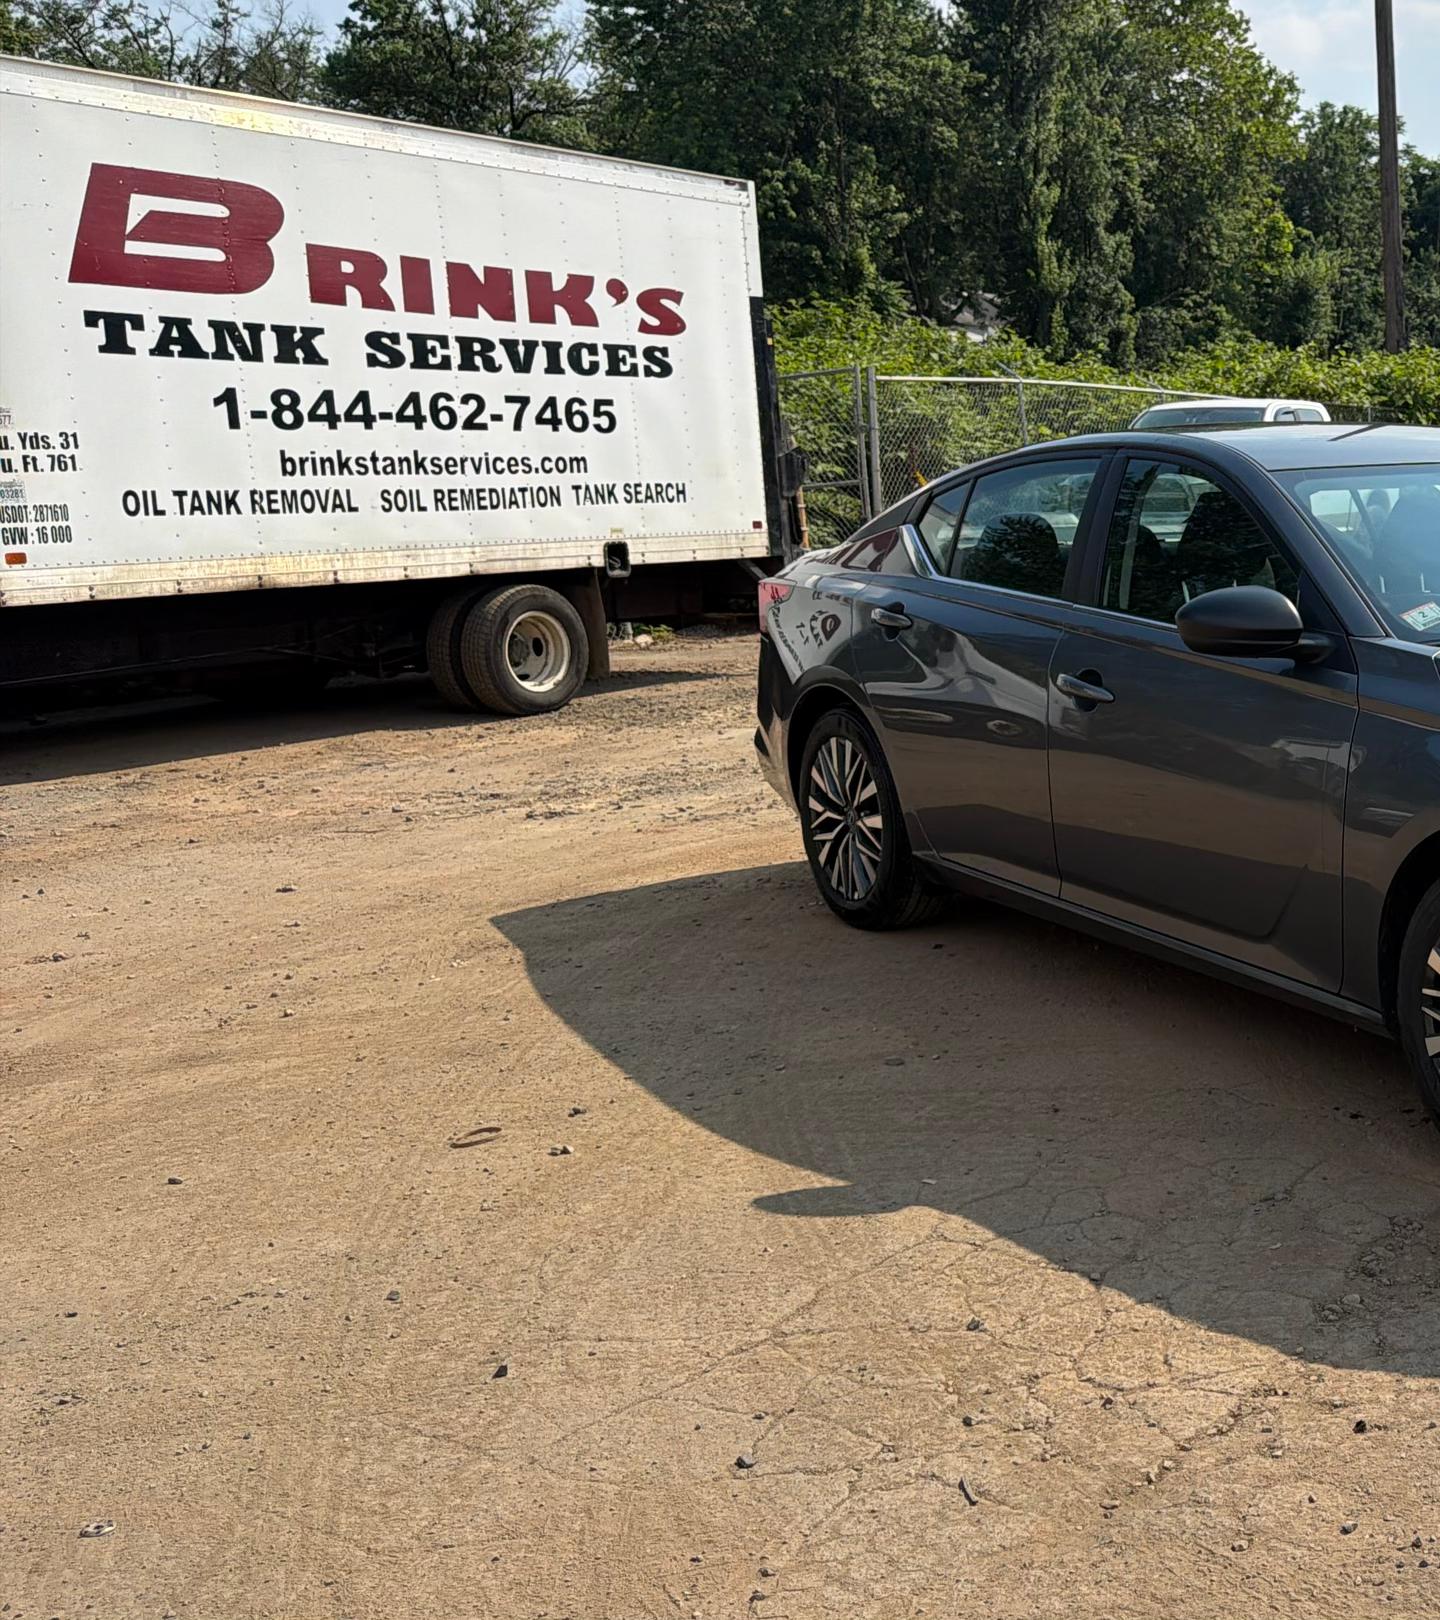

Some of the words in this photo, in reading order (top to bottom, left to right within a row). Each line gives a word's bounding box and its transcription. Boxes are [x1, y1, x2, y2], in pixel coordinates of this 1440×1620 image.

[68, 162, 686, 336] BRINK'S
[83, 310, 329, 366] TANK
[365, 331, 673, 378] SERVICES
[213, 387, 617, 434] 1-844-462-7465
[17, 432, 56, 450] Yds.
[59, 432, 79, 449] 31
[22, 455, 44, 473] Ft.
[47, 454, 77, 472] 761
[280, 449, 588, 477] brinkstankservices.com
[122, 490, 166, 516] OIL
[172, 490, 242, 516] TANK
[250, 489, 359, 514] REMOVAL
[380, 488, 427, 513] SOIL
[433, 485, 562, 512] REMEDIATION
[572, 483, 619, 506] TANK
[623, 482, 687, 504] SEARCH
